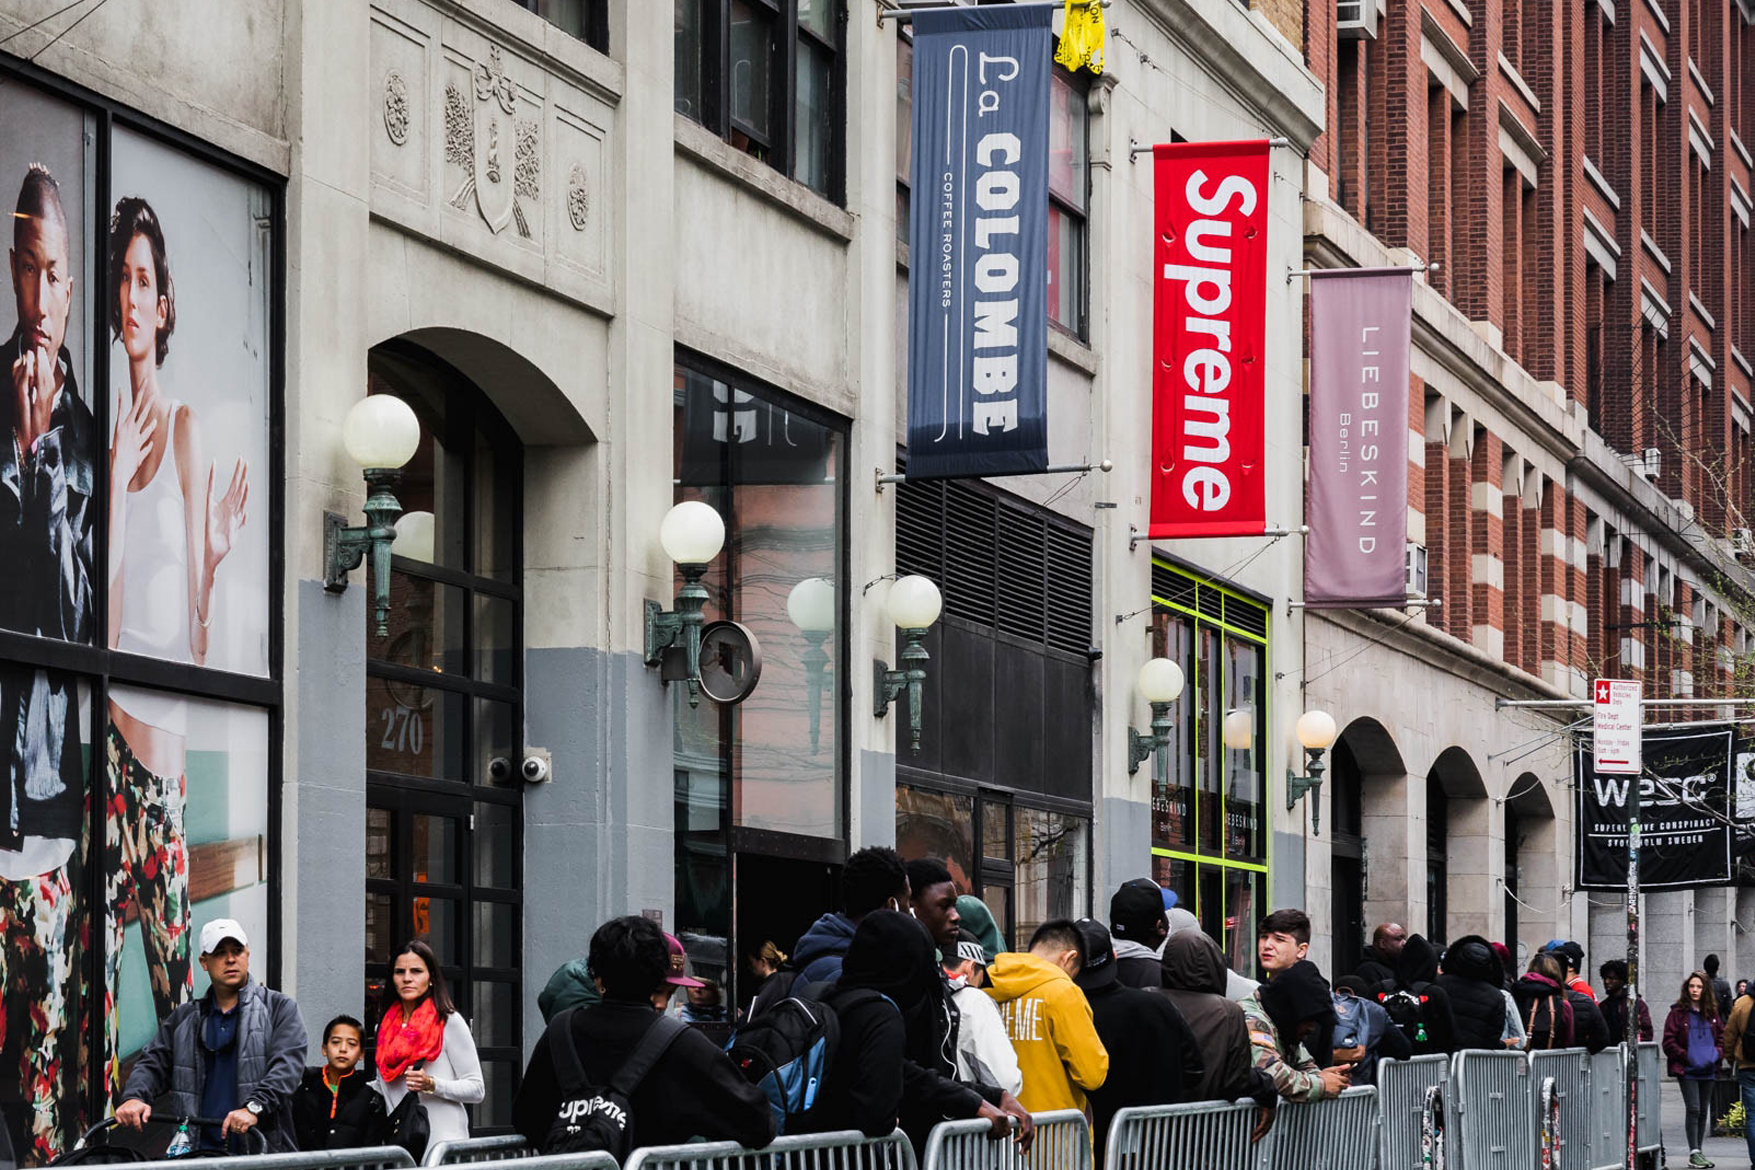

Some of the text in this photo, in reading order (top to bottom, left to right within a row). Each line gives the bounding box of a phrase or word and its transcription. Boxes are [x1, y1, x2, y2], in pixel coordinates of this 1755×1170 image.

[942, 171, 953, 308] COFFEE ROASTERS
[972, 51, 1021, 437] La COLOMBE
[1164, 168, 1258, 512] Supreme
[1338, 412, 1351, 474] Berlin
[1359, 326, 1380, 555] LIEBESKIND
[381, 706, 424, 755] 270
[1594, 818, 1717, 832] SUPERLIVE CONSPIRACY
[1607, 834, 1704, 848] STOOLM SWEDEN
